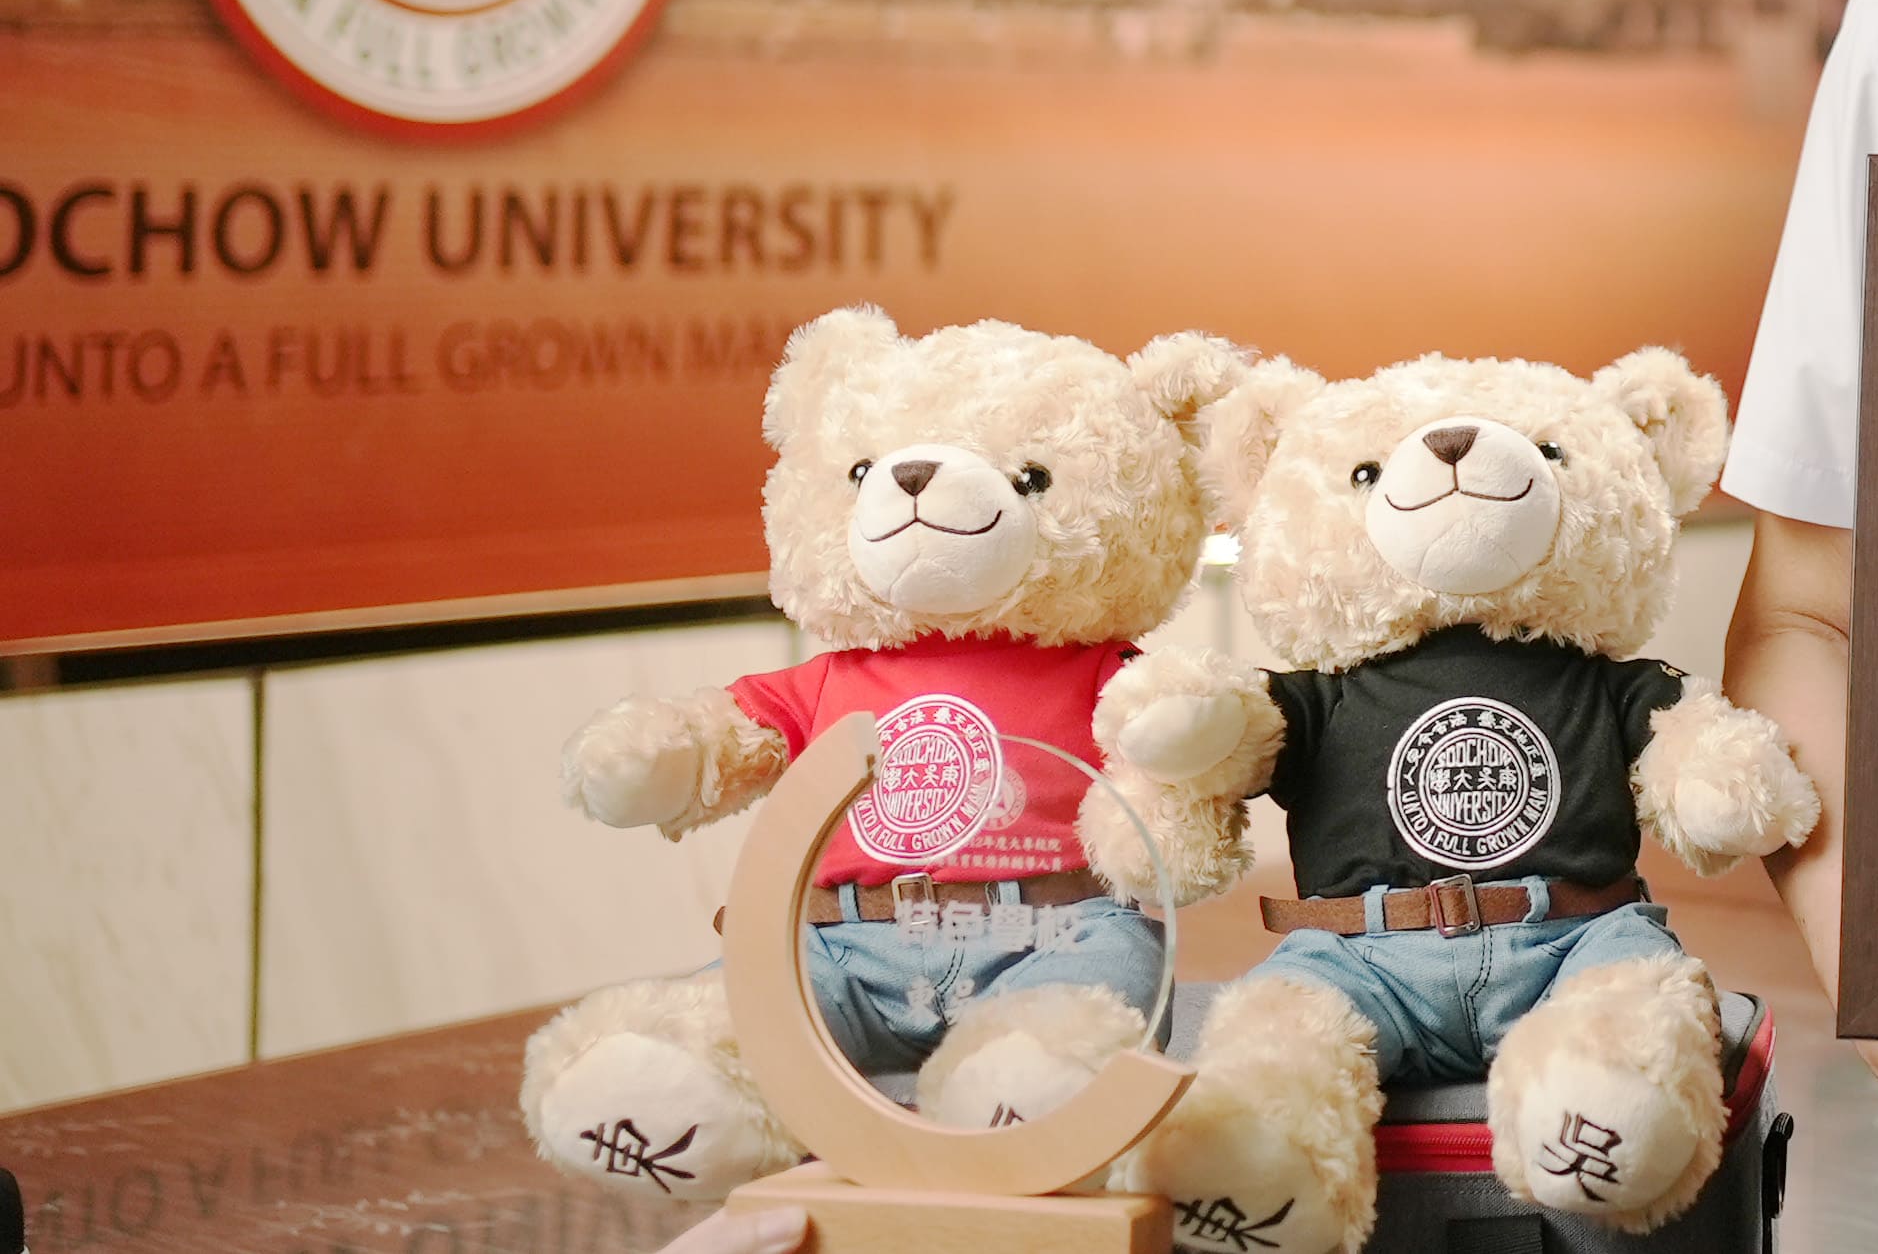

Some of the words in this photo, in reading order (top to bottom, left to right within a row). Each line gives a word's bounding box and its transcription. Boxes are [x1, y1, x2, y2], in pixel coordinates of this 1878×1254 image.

[423, 182, 957, 275] UNIVERSITY
[200, 326, 249, 400] A
[265, 322, 420, 398] FULL
[1433, 737, 1515, 769] SOOCHOW
[876, 828, 907, 851] FULL
[911, 813, 966, 851] GROWN
[1402, 790, 1429, 831] UNTO
[1423, 830, 1437, 847] A
[1433, 831, 1472, 856] FULL
[1476, 816, 1529, 855] GROWN
[1524, 786, 1548, 824] MAN
[1430, 790, 1516, 825] UNIVERSITY
